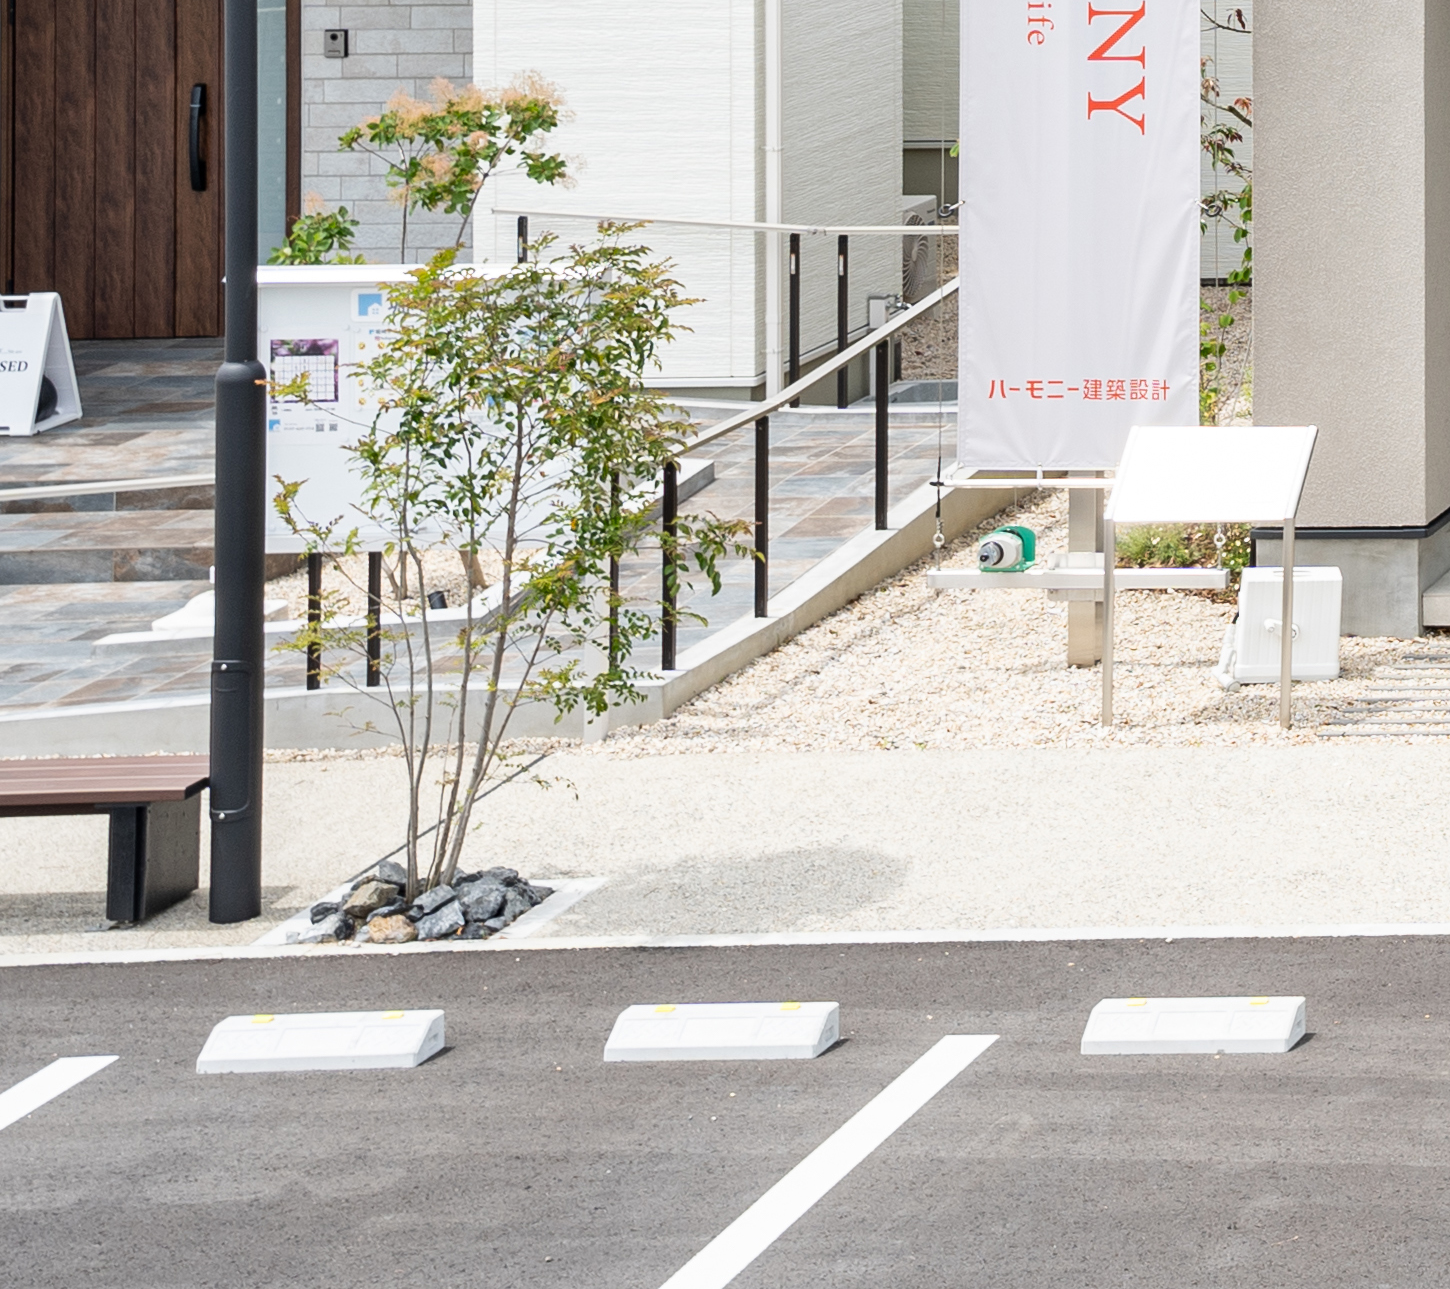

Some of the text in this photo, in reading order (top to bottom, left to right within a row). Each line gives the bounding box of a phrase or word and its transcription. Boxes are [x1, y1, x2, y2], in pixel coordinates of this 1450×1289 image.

[988, 378, 1170, 401] ハーモニー建築設計
